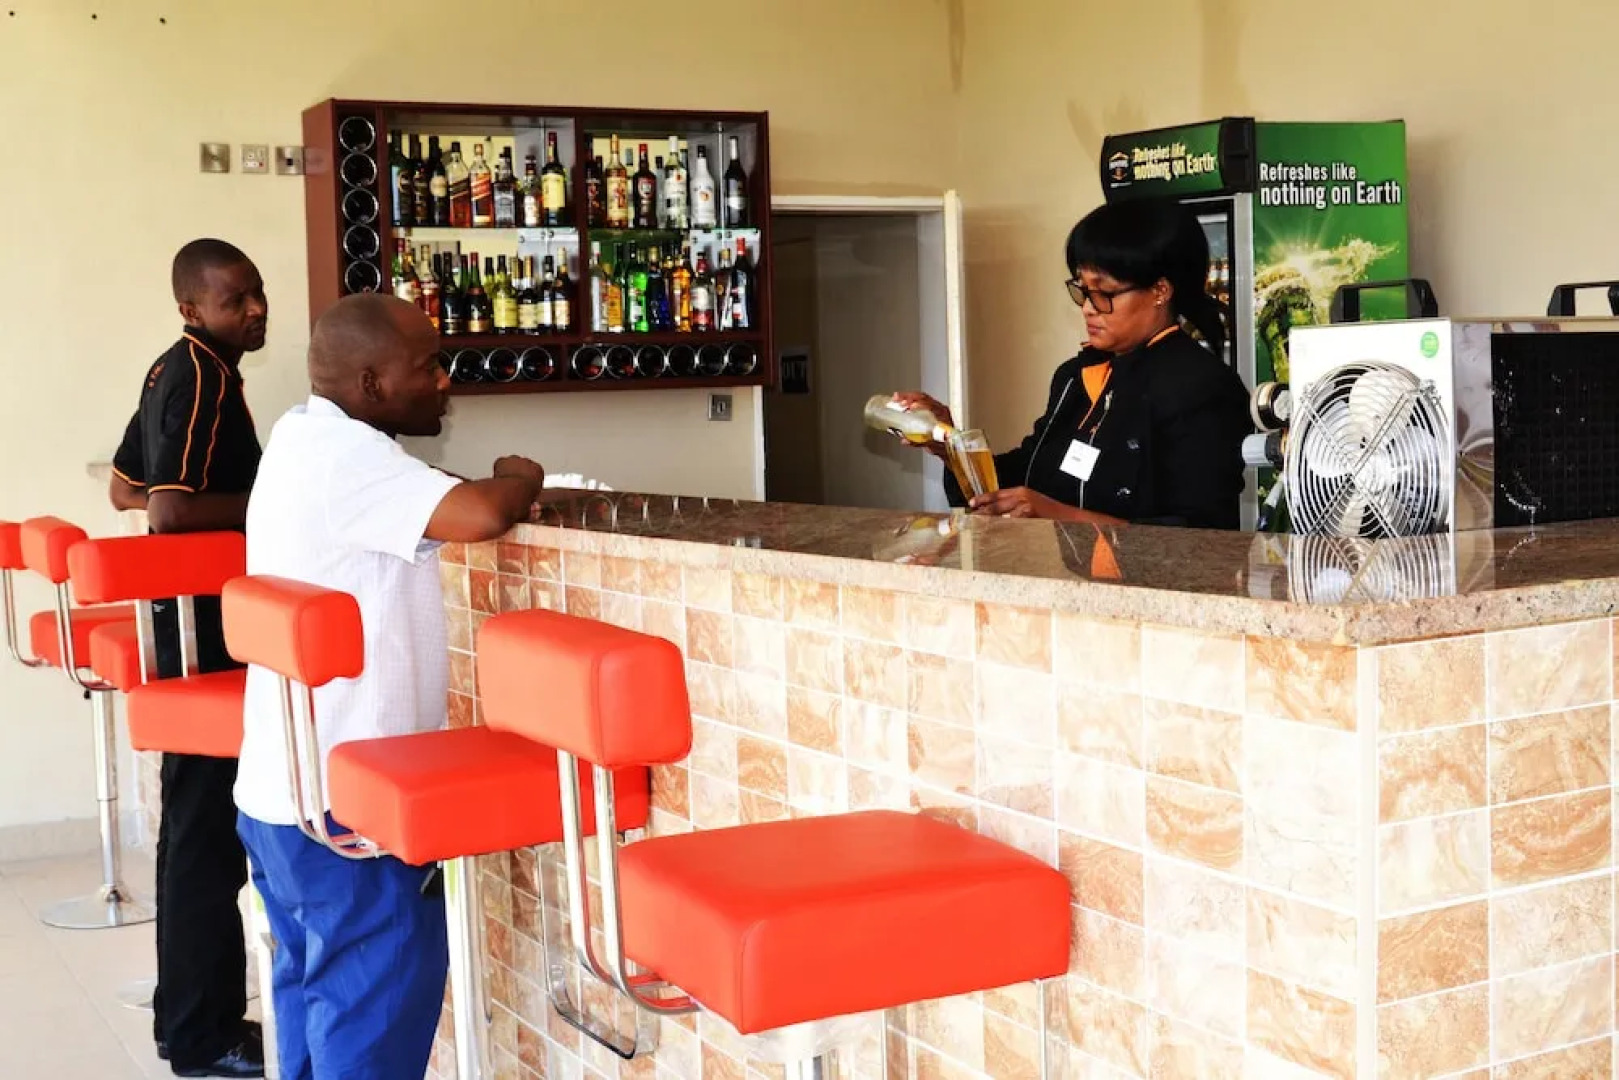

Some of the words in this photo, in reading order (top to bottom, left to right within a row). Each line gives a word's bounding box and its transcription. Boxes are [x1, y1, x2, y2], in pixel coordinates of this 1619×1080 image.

[1172, 142, 1185, 157] like
[1133, 160, 1171, 181] nothing
[1172, 160, 1186, 178] on
[1186, 152, 1216, 175] Earth
[1260, 163, 1327, 181] Refreshes
[1332, 162, 1356, 180] like
[1260, 182, 1327, 209] nothing
[1331, 186, 1351, 204] on
[1356, 181, 1401, 204] Earth
